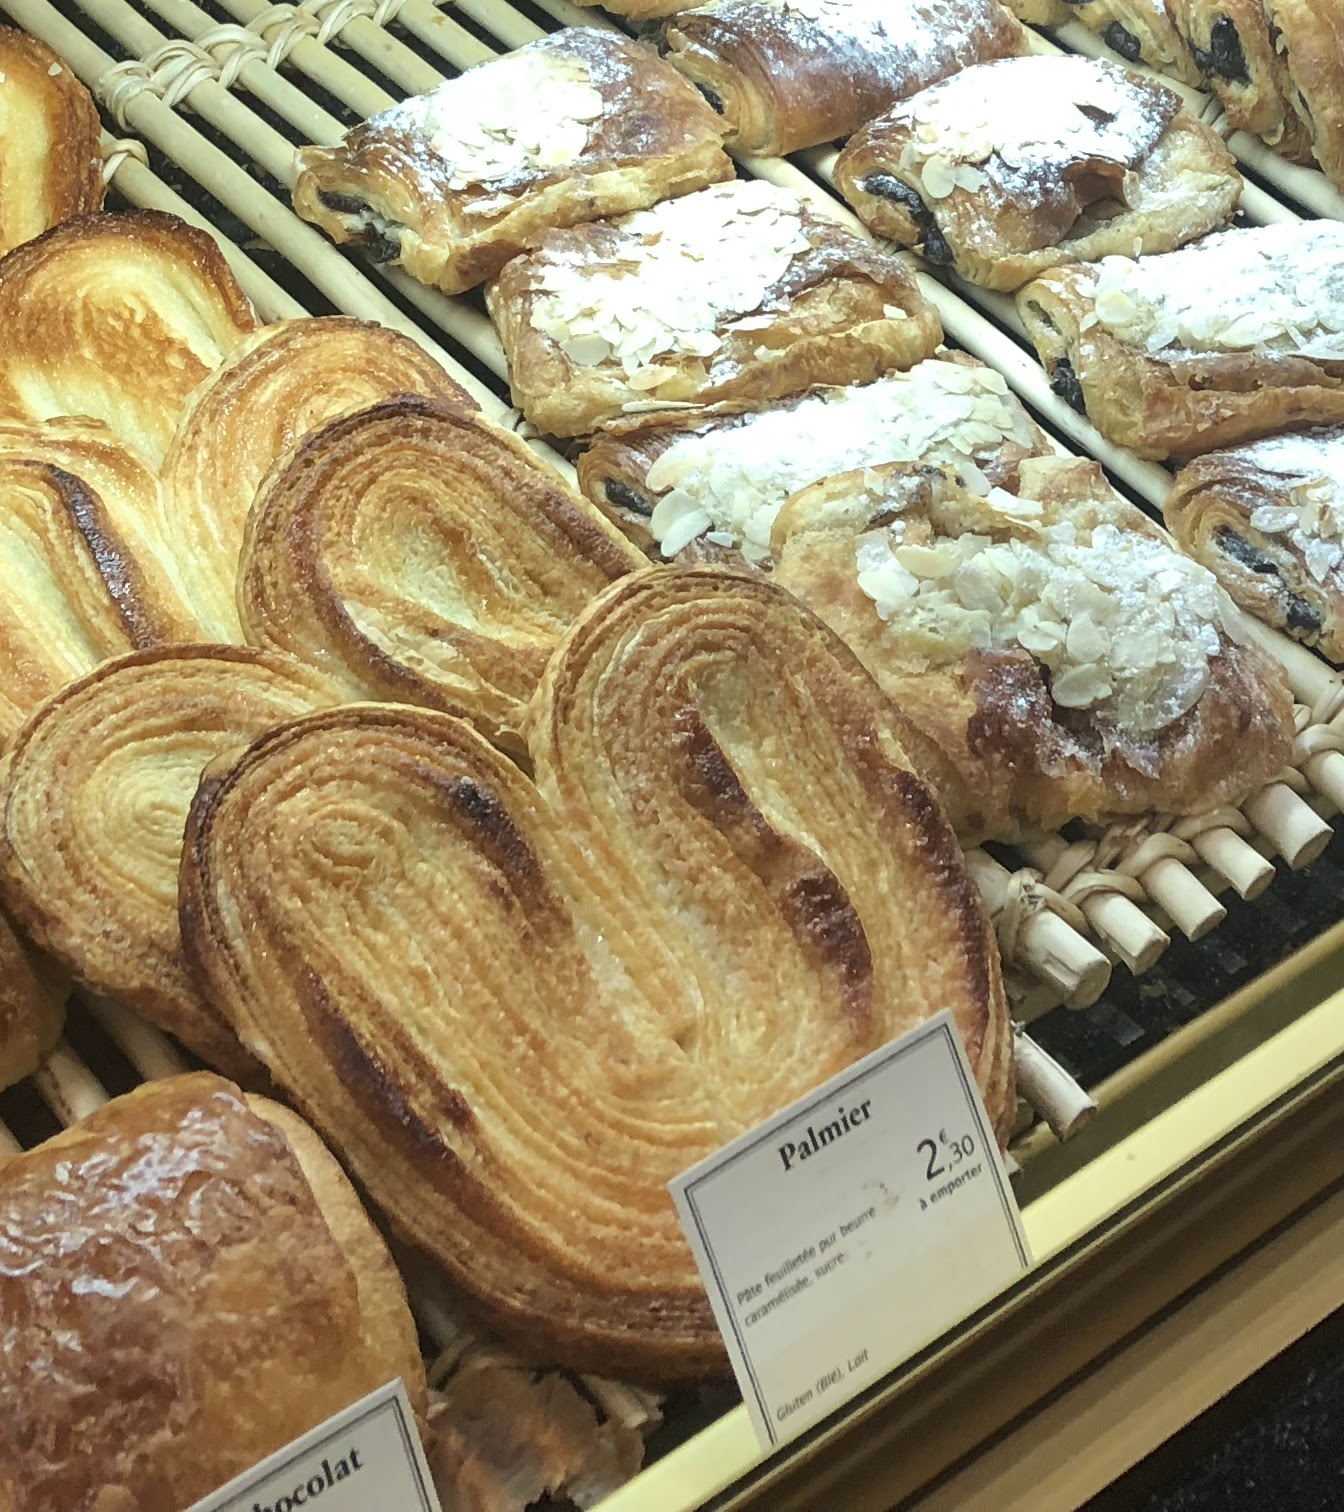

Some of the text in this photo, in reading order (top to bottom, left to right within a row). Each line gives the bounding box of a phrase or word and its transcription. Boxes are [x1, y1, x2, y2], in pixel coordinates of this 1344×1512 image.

[777, 1097, 873, 1172] Palmier
[919, 1160, 984, 1211] à emporter
[736, 1283, 763, 1306] Pâte
[818, 1232, 837, 1254] pur
[839, 1206, 876, 1238] beurre
[814, 1252, 845, 1280] sucre
[776, 1388, 814, 1423] Gluten
[846, 1348, 870, 1375] Lait
